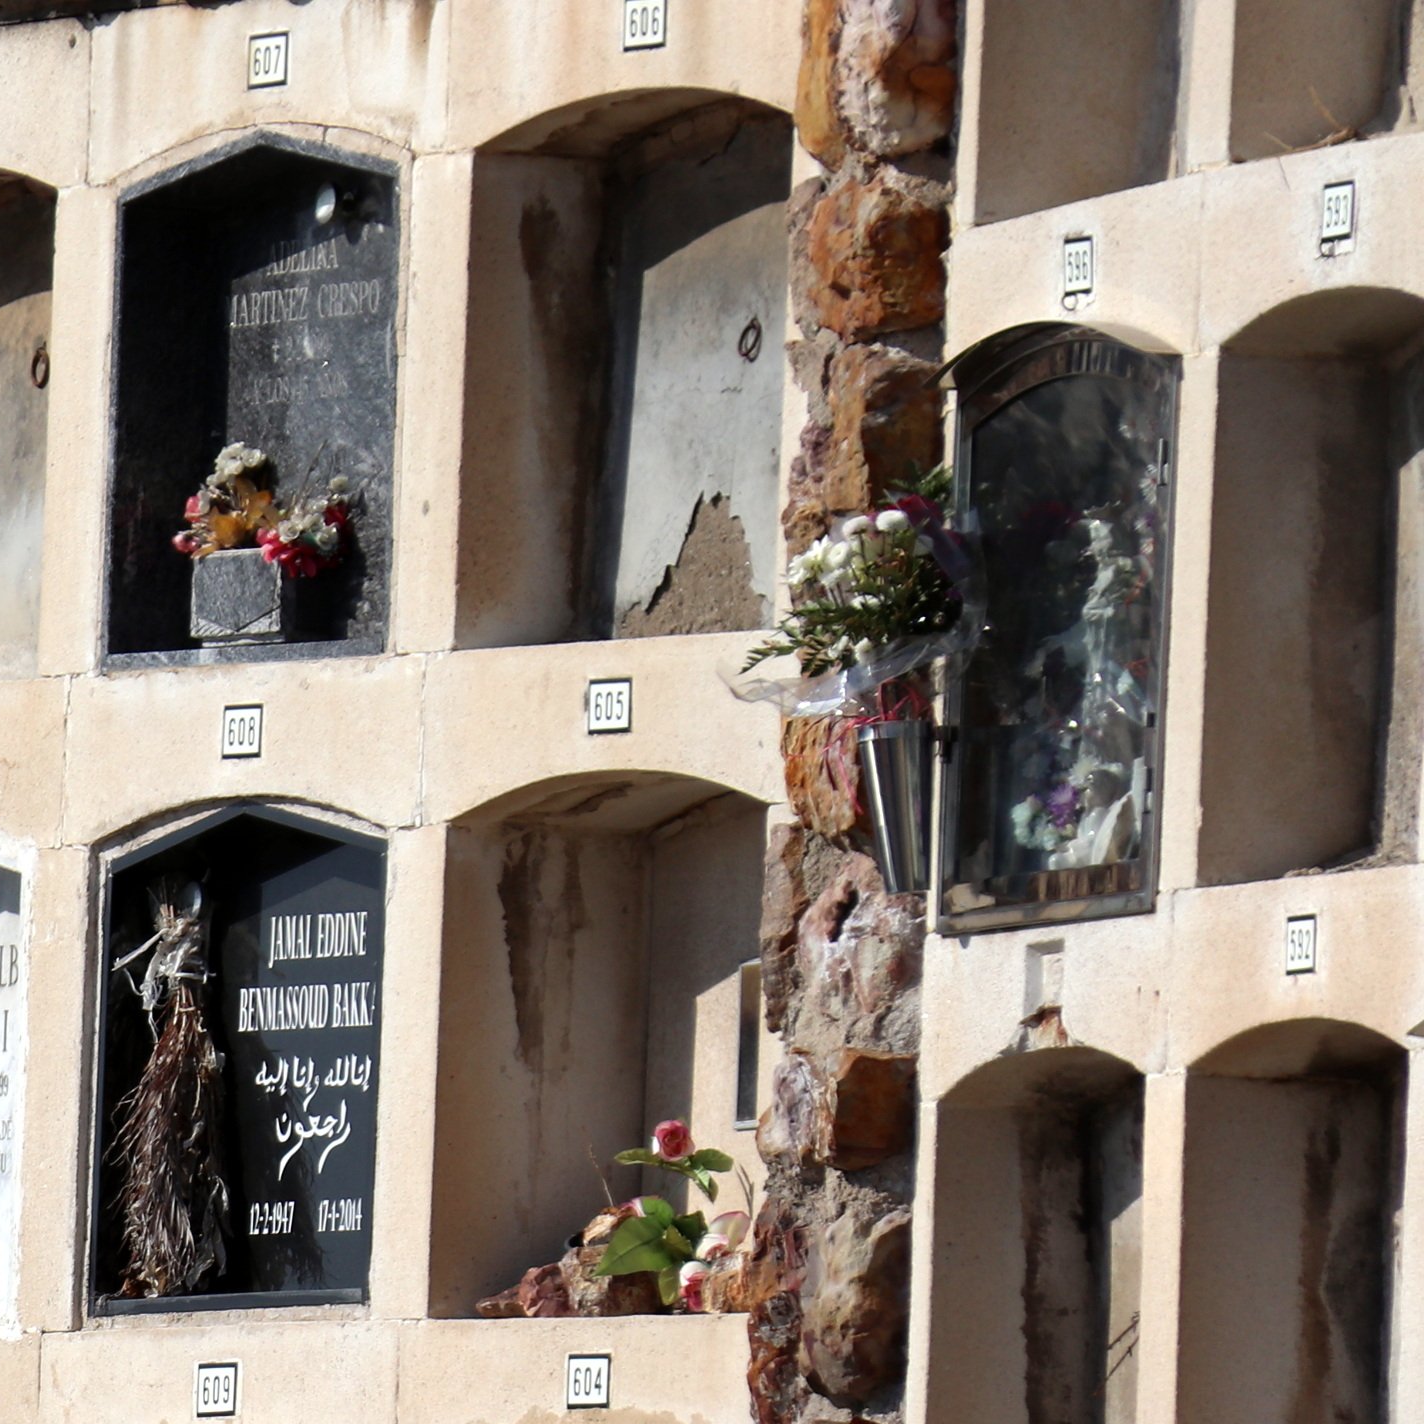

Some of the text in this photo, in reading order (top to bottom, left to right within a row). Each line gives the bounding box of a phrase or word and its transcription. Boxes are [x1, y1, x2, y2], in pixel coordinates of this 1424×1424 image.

[629, 6, 661, 38] 606
[253, 45, 281, 77] 607
[1325, 194, 1349, 229] 593
[1067, 250, 1089, 283] 596
[594, 690, 625, 721] 605
[228, 716, 256, 746] 608
[268, 912, 367, 969] JAMAL EDDINE
[1290, 929, 1312, 961] 592
[238, 985, 328, 1033] BENMASSOUD
[202, 1375, 231, 1406] 609
[573, 1366, 603, 1396] 604
